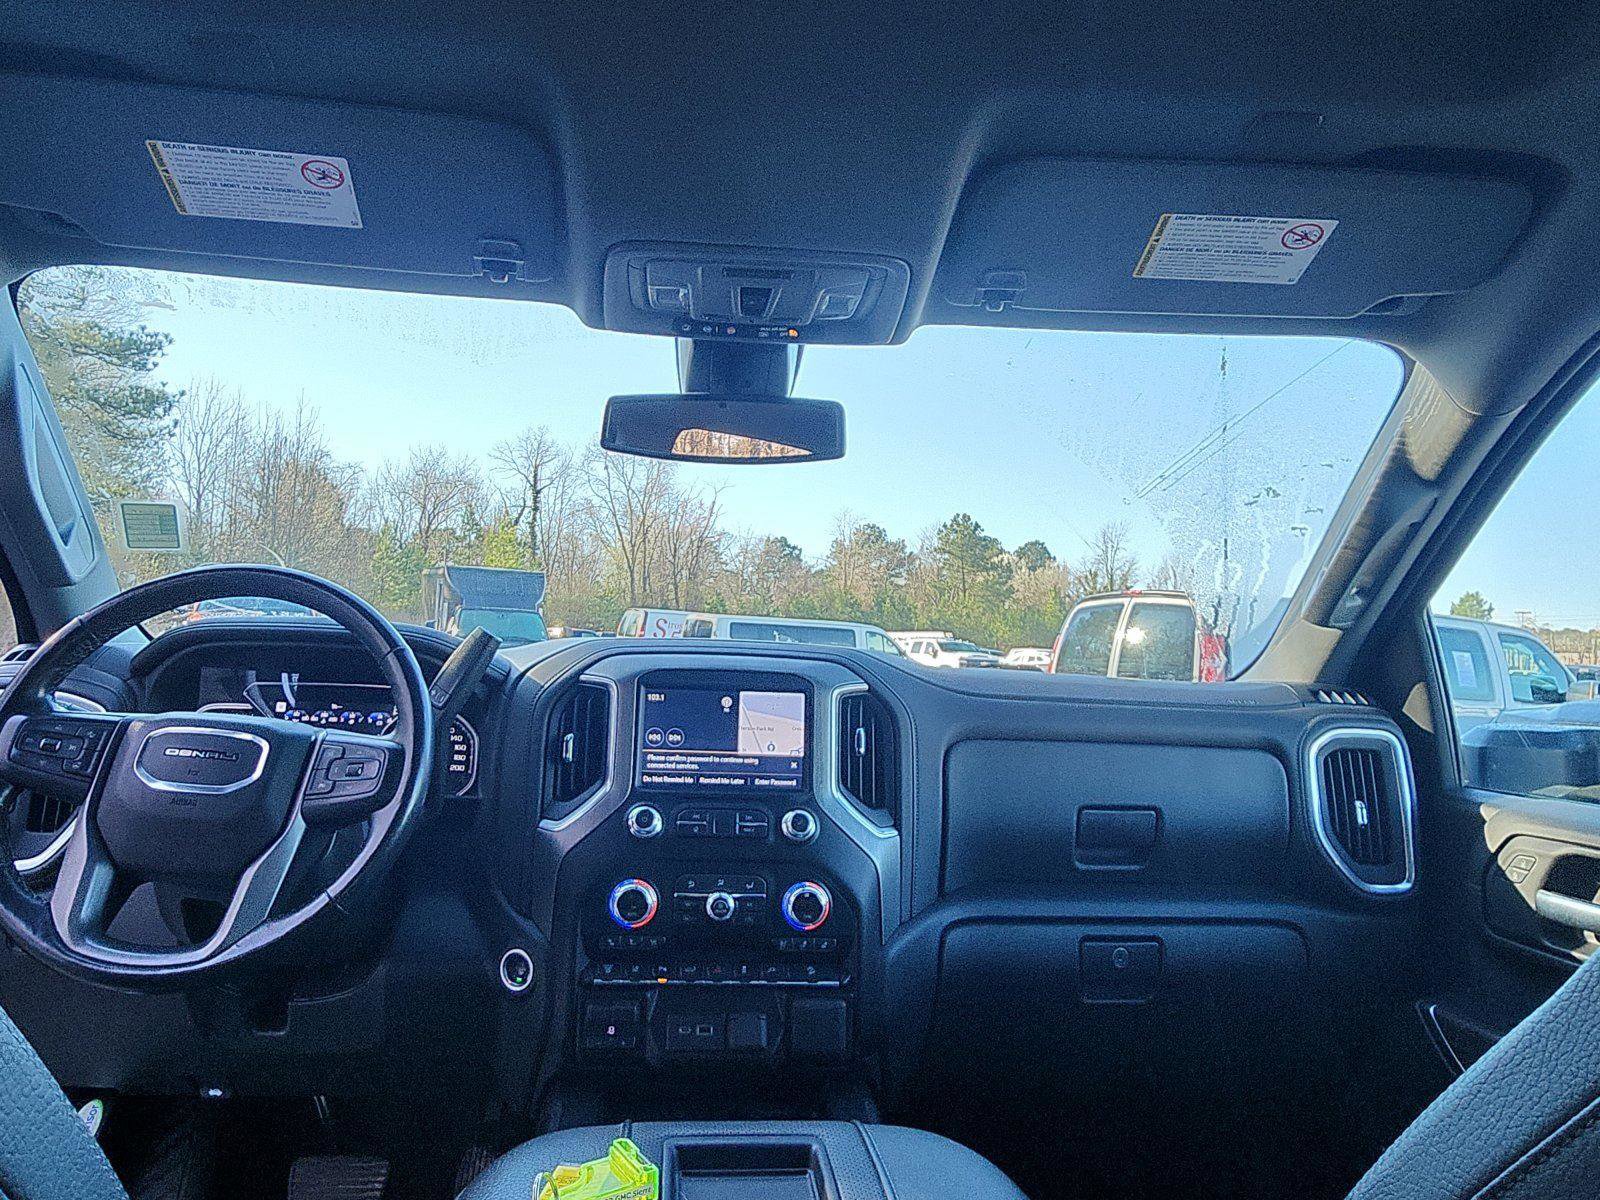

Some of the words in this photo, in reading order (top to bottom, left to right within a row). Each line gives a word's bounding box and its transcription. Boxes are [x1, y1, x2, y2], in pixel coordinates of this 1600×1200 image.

[161, 143, 187, 151] DEATH
[647, 693, 665, 702] 103.1
[450, 734, 463, 742] 140
[164, 748, 237, 760] DENALI
[687, 755, 713, 763] password
[450, 764, 465, 772] 200
[643, 775, 651, 783] Do
[730, 777, 745, 785] Later
[770, 778, 796, 786] Password
[615, 1191, 632, 1200] GMC
